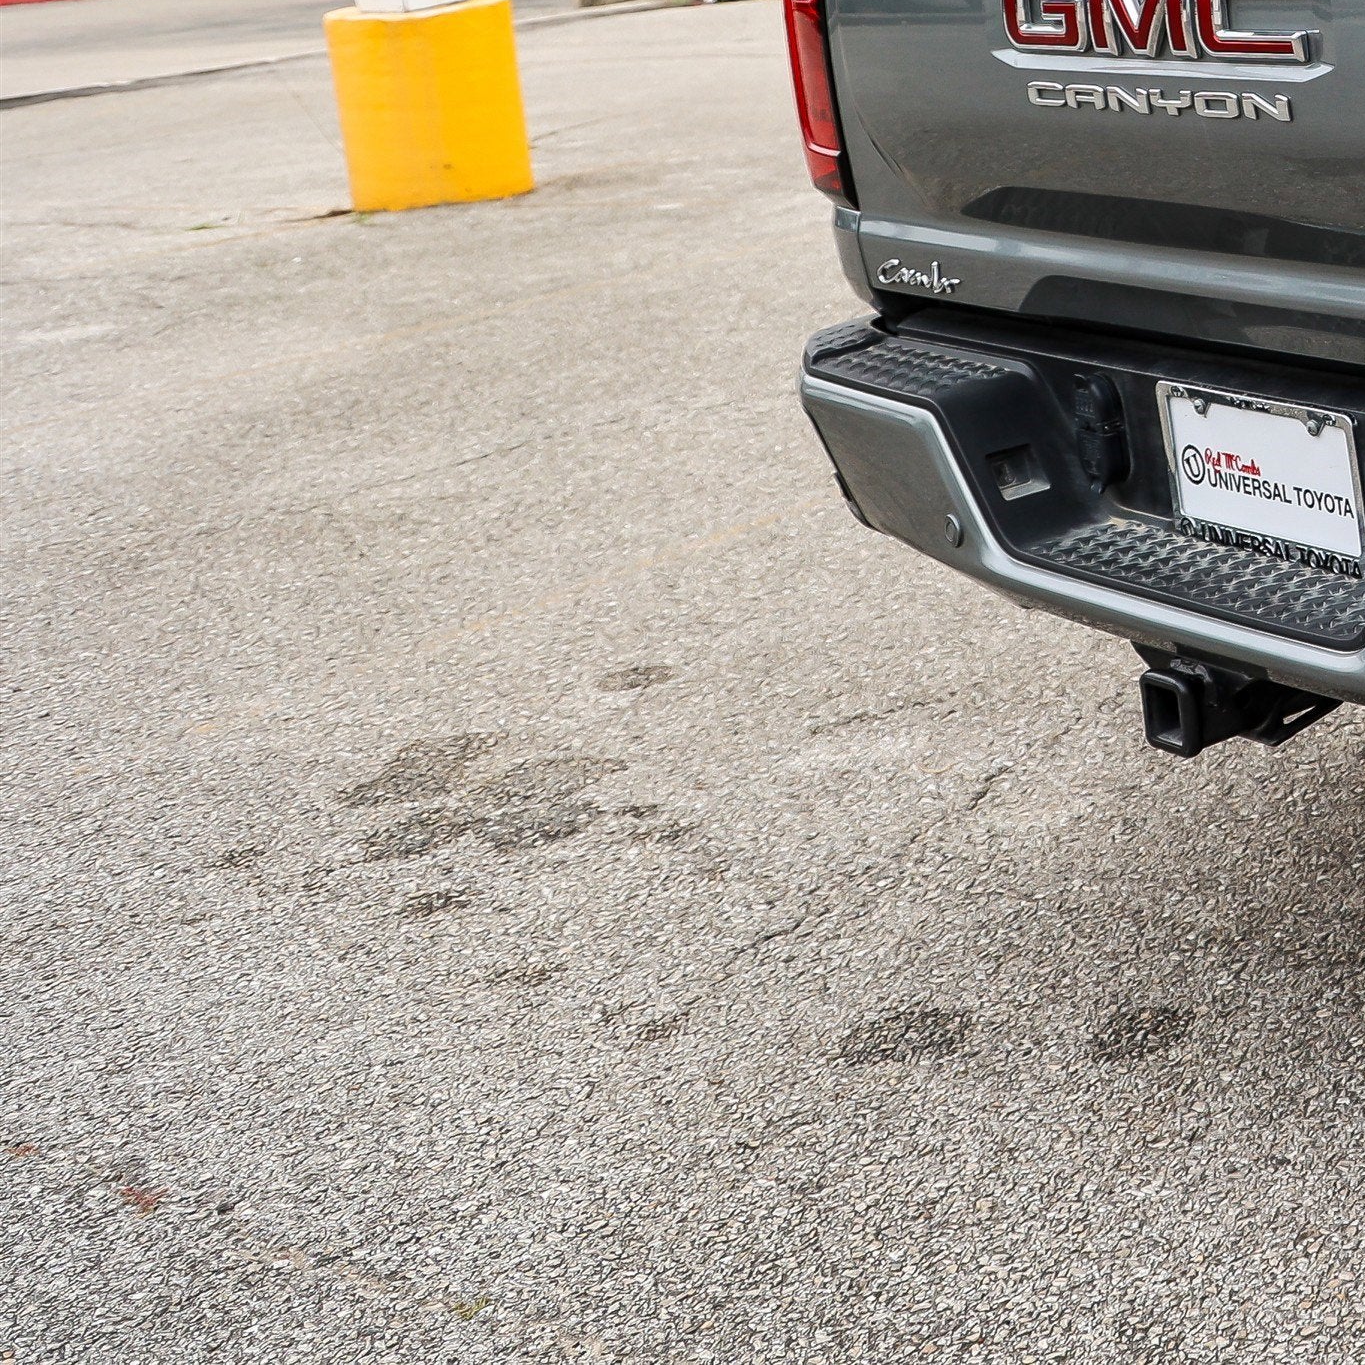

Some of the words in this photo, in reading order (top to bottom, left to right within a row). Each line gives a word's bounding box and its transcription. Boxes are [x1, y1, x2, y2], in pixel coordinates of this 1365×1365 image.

[1026, 81, 1293, 122] CANYON
[1204, 447, 1222, 470] Red
[1206, 467, 1293, 505] UNIVERSAL
[1293, 485, 1355, 520] TOYOTA
[1201, 520, 1296, 563] UNIVERSAL
[1296, 546, 1363, 580] TOYOTA
